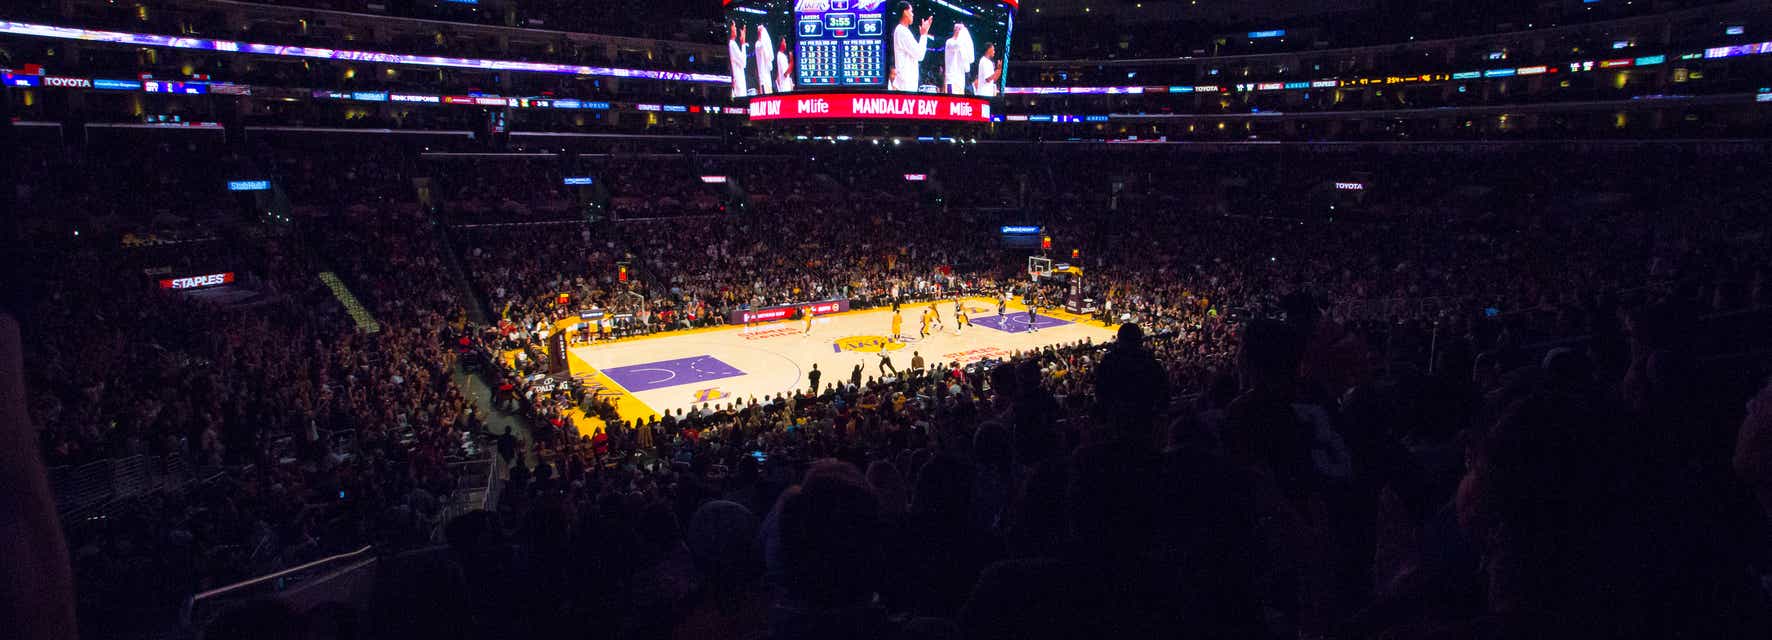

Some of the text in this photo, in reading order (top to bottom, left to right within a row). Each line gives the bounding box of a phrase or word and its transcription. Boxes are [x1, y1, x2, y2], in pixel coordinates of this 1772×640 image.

[830, 17, 850, 26] 3:55
[805, 24, 816, 33] 97
[864, 23, 876, 32] 96
[46, 77, 91, 87] TOYOTA
[768, 100, 780, 115] BAY
[853, 98, 938, 115] MANDALAY BAY
[1335, 182, 1363, 190] TOYOTA
[172, 273, 224, 289] STAPLES
